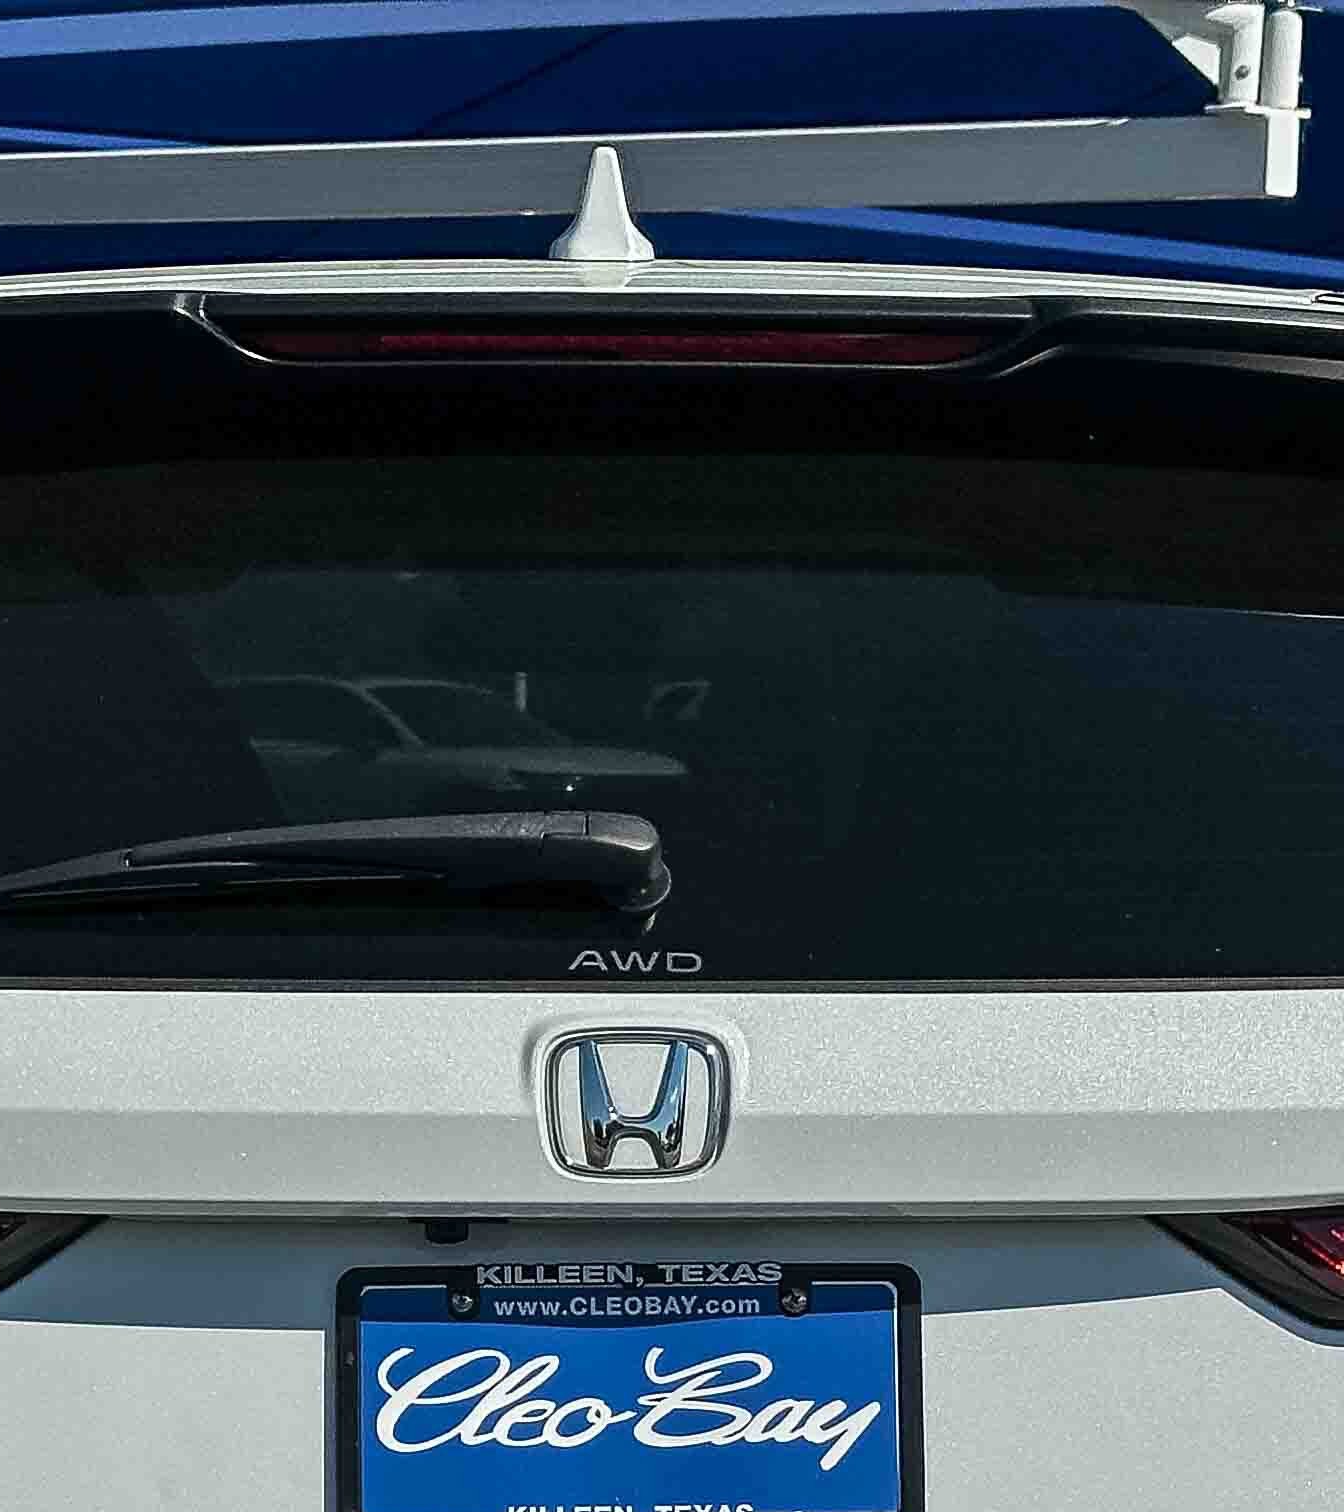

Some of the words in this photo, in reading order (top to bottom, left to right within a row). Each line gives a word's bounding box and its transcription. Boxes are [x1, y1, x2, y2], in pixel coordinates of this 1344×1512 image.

[568, 950, 703, 973] AWD
[476, 1263, 644, 1287] KILLEEN,
[658, 1262, 783, 1284] TEXAS
[494, 1294, 761, 1317] www.CLEOBAY.com
[375, 1347, 636, 1453] Cleo
[632, 1346, 881, 1471] Bay
